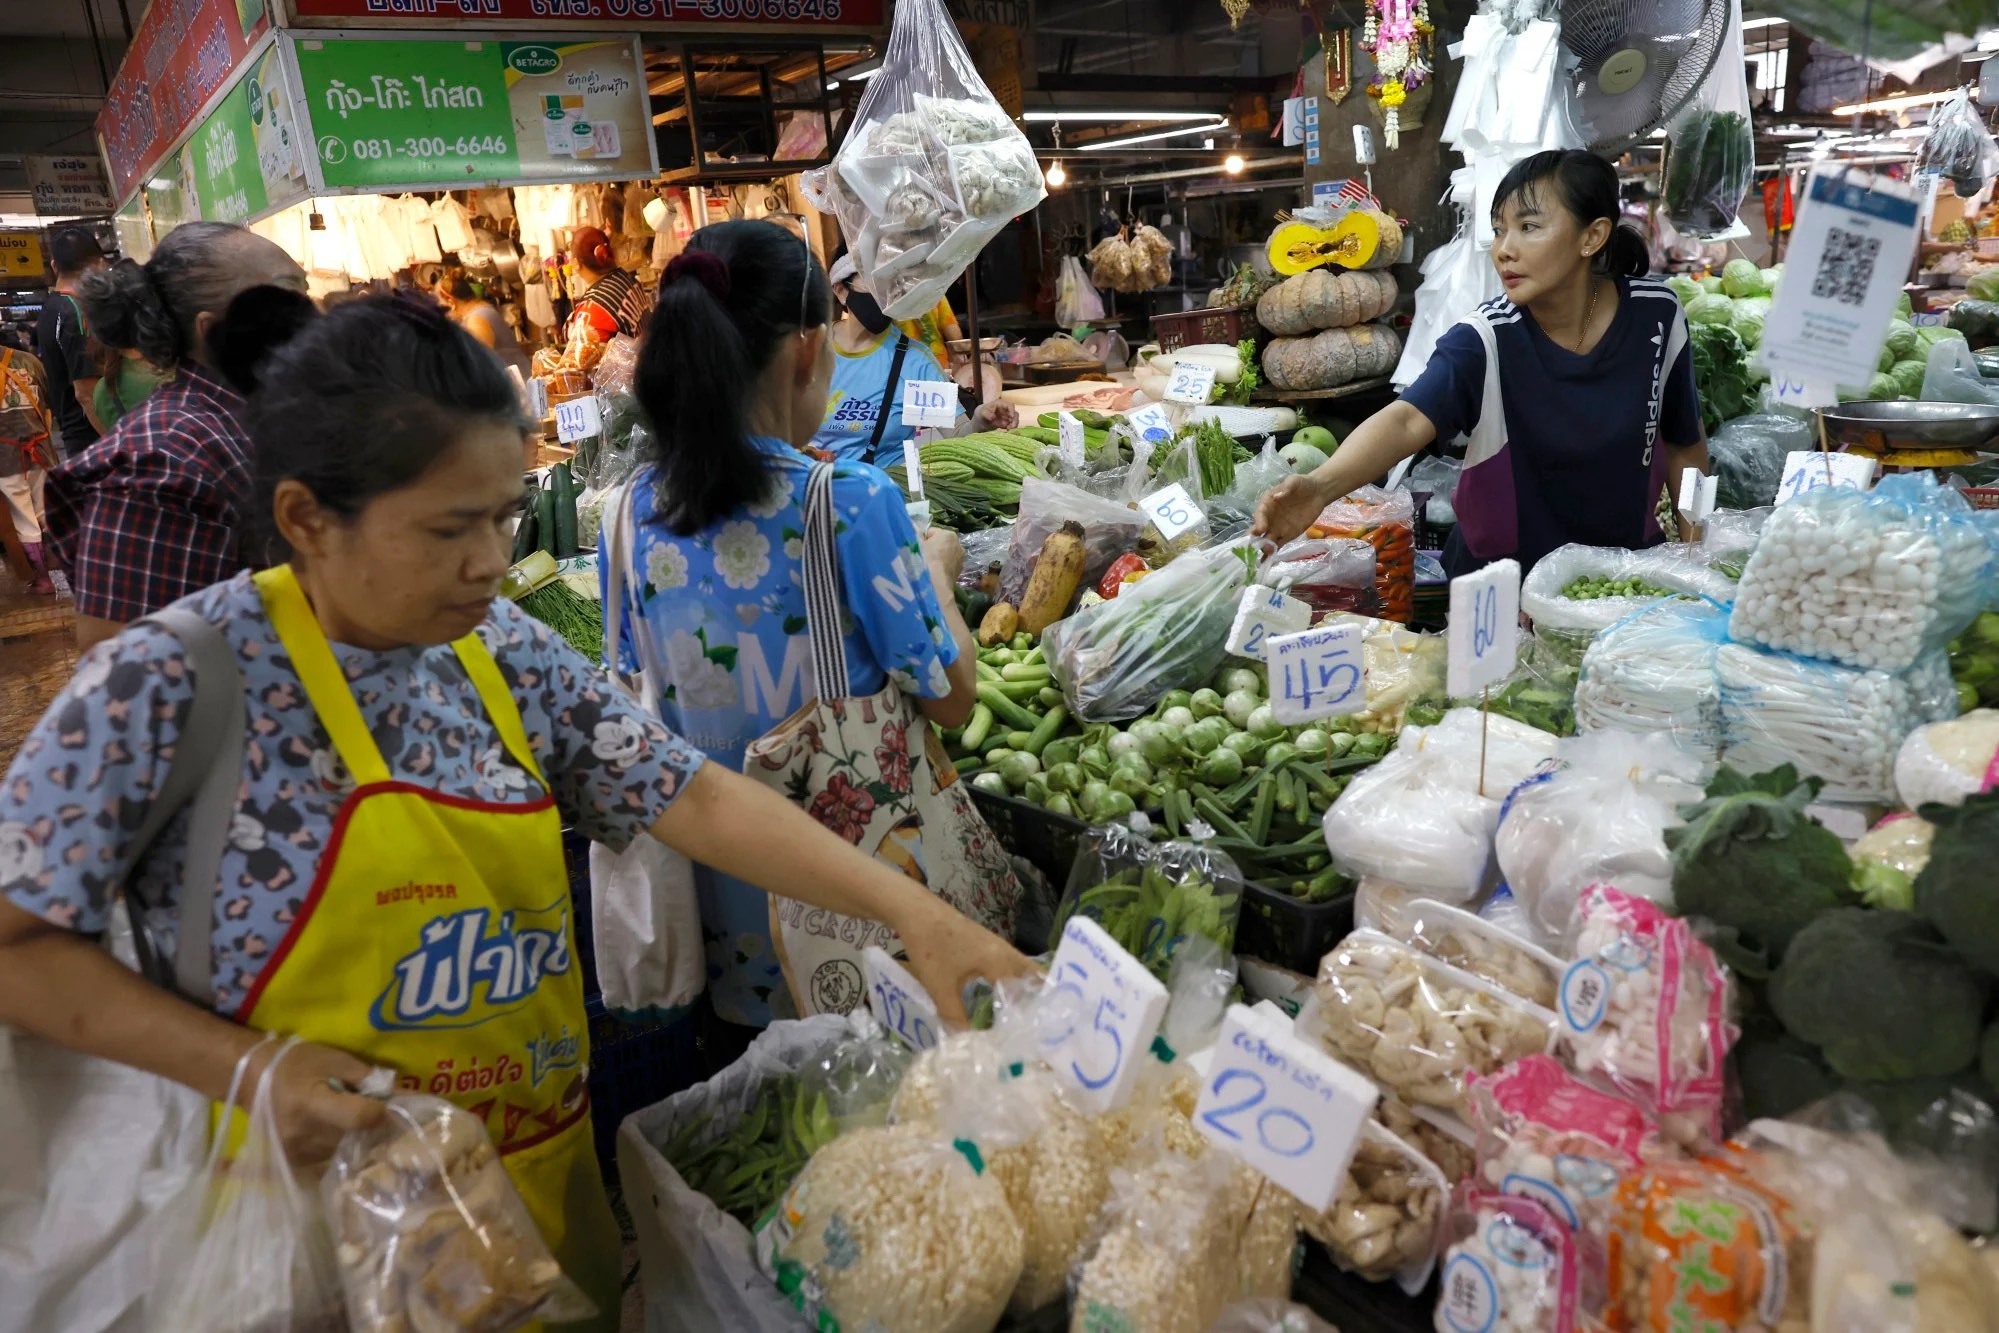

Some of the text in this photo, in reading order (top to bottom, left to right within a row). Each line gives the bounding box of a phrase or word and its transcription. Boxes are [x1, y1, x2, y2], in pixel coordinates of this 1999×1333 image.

[515, 58, 557, 68] BETAGRO
[326, 75, 483, 119] กุ้ง-โก๊ะ ไก่สด
[353, 135, 507, 160] 081-300-6646
[841, 397, 871, 409] ก้าว
[1173, 374, 1207, 395] 25
[1642, 363, 1659, 467] adidas
[1157, 497, 1188, 526] 60
[1473, 585, 1496, 658] 60
[1284, 650, 1360, 710] 45
[429, 1054, 524, 1093] ดีต่อใจ
[1203, 1068, 1315, 1157] 20
